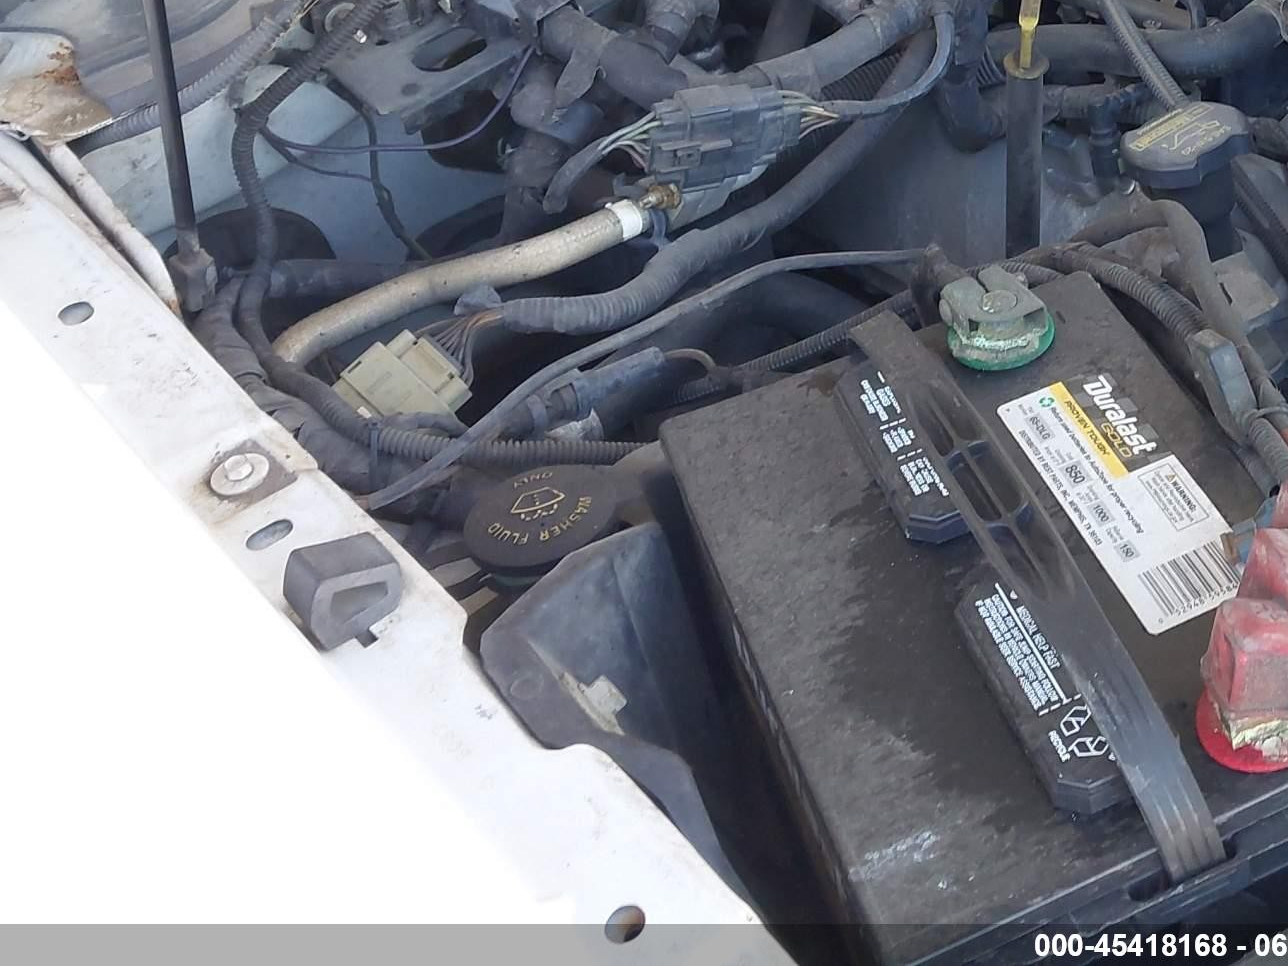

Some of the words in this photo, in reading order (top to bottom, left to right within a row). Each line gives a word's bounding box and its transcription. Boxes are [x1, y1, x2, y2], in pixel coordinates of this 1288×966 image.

[1064, 400, 1089, 430] PROVEN
[1083, 375, 1158, 454] Duralast
[1101, 422, 1133, 458] GOLD
[514, 472, 553, 489] ONLY
[1065, 464, 1086, 485] 850
[1171, 480, 1197, 512] WARNING:
[539, 496, 592, 541] WASHER
[1093, 504, 1110, 523] 1000
[488, 522, 529, 546] FLUID
[1118, 542, 1134, 558] 150
[1031, 632, 1050, 652] HELP
[1041, 649, 1060, 670] FAST
[1049, 730, 1070, 762] RECYCLE
